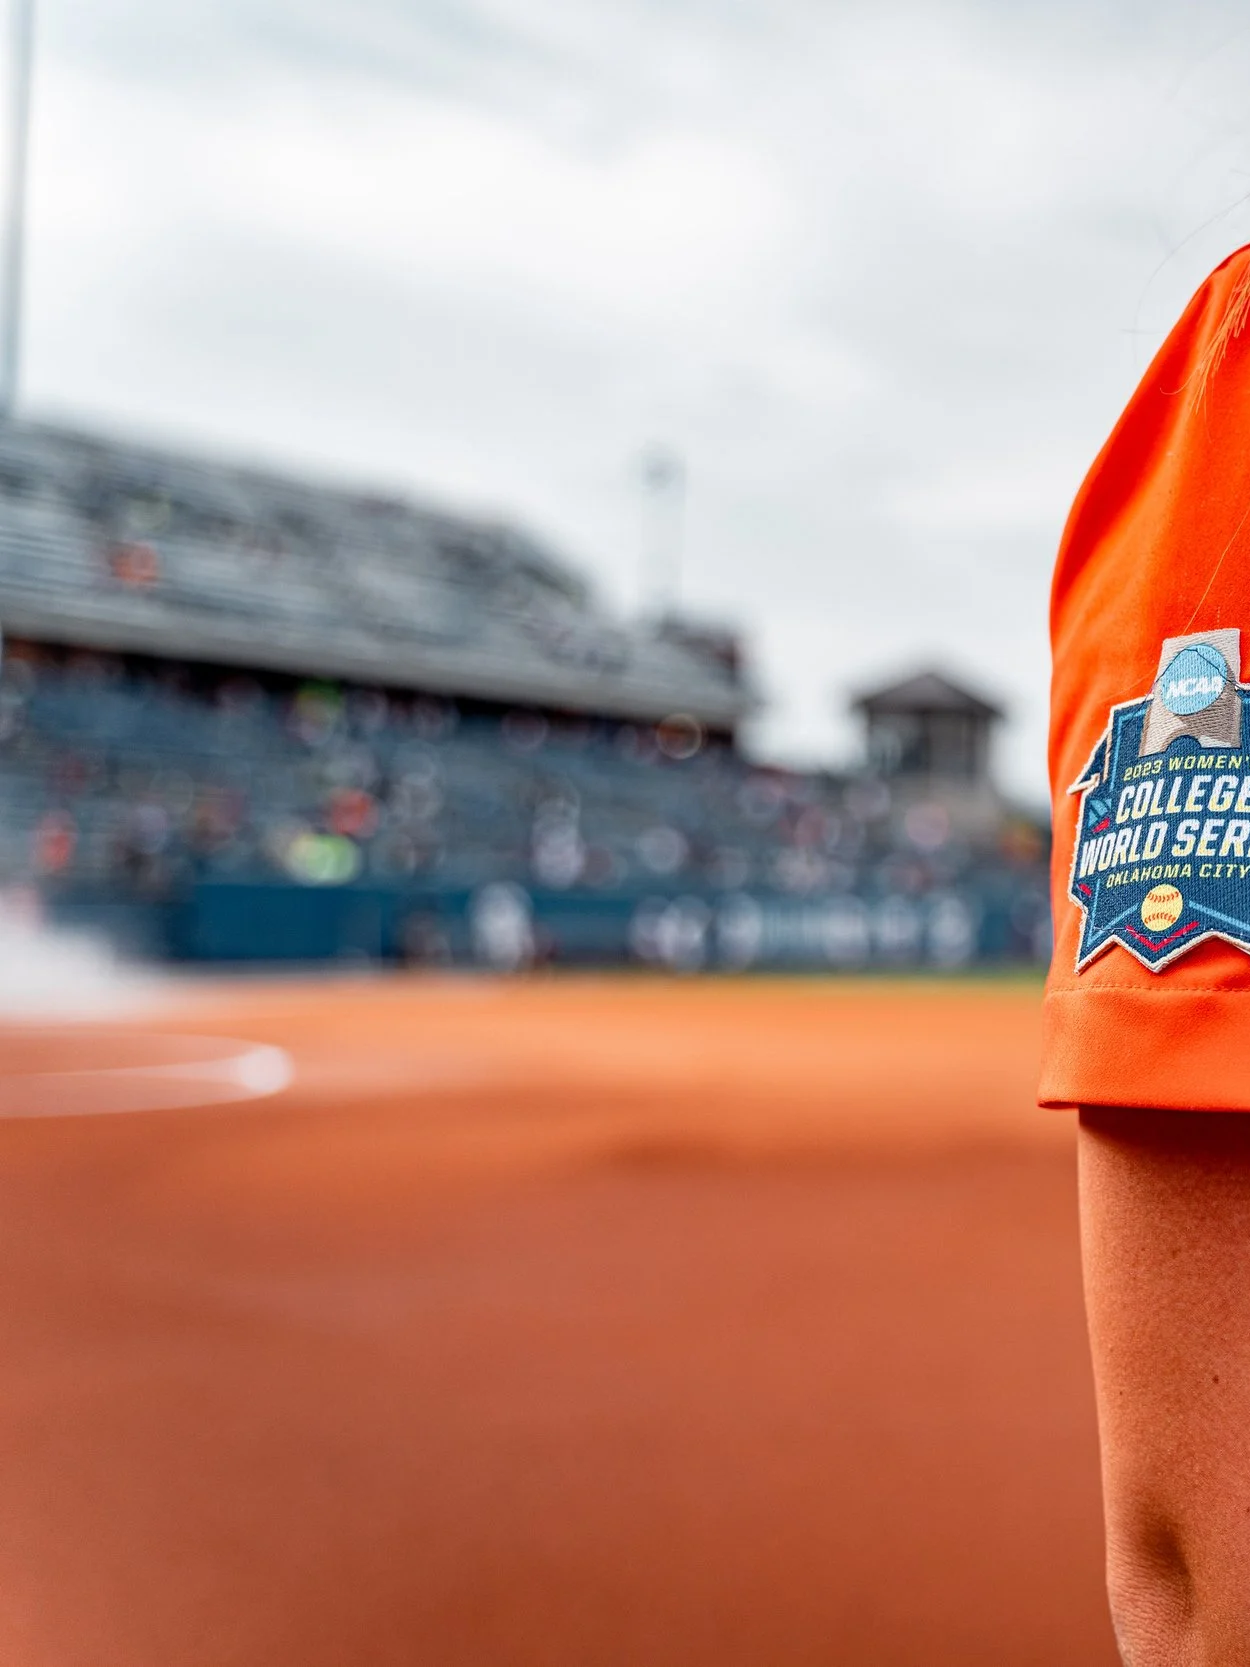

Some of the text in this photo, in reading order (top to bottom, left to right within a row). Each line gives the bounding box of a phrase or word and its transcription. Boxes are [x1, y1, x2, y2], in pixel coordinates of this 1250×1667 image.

[1124, 761, 1163, 780] 2023
[1079, 823, 1168, 878] WORLD
[1106, 864, 1192, 888] OKLAHOMA
